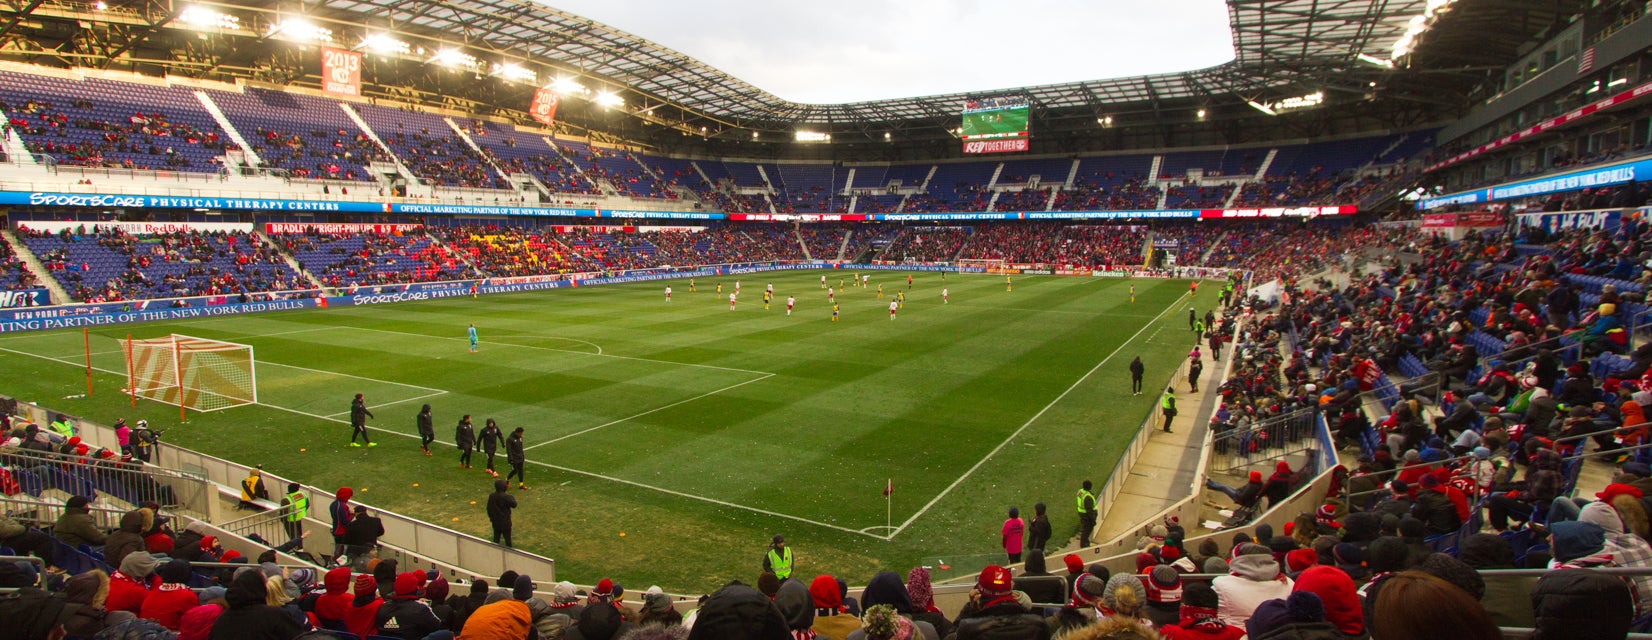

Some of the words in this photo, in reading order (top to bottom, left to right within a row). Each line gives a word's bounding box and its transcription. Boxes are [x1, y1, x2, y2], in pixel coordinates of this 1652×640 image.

[325, 50, 358, 72] 2013
[536, 91, 558, 106] 2015
[150, 198, 222, 208] PHYSICAL
[226, 200, 285, 209] THERAPY
[288, 202, 340, 210] CENTERS
[272, 224, 308, 233] BRADLEY
[381, 224, 391, 232] 69
[482, 284, 521, 294] THERAPY
[524, 282, 558, 291] CENTERS
[0, 320, 40, 332] TING
[45, 315, 116, 328] PARTNER
[118, 313, 137, 323] OF
[140, 310, 168, 320] THE
[171, 308, 201, 320] NEW
[204, 306, 239, 316] YORK
[242, 304, 266, 313] RED
[269, 301, 304, 311] BULLS
[35, 310, 57, 318] YORK
